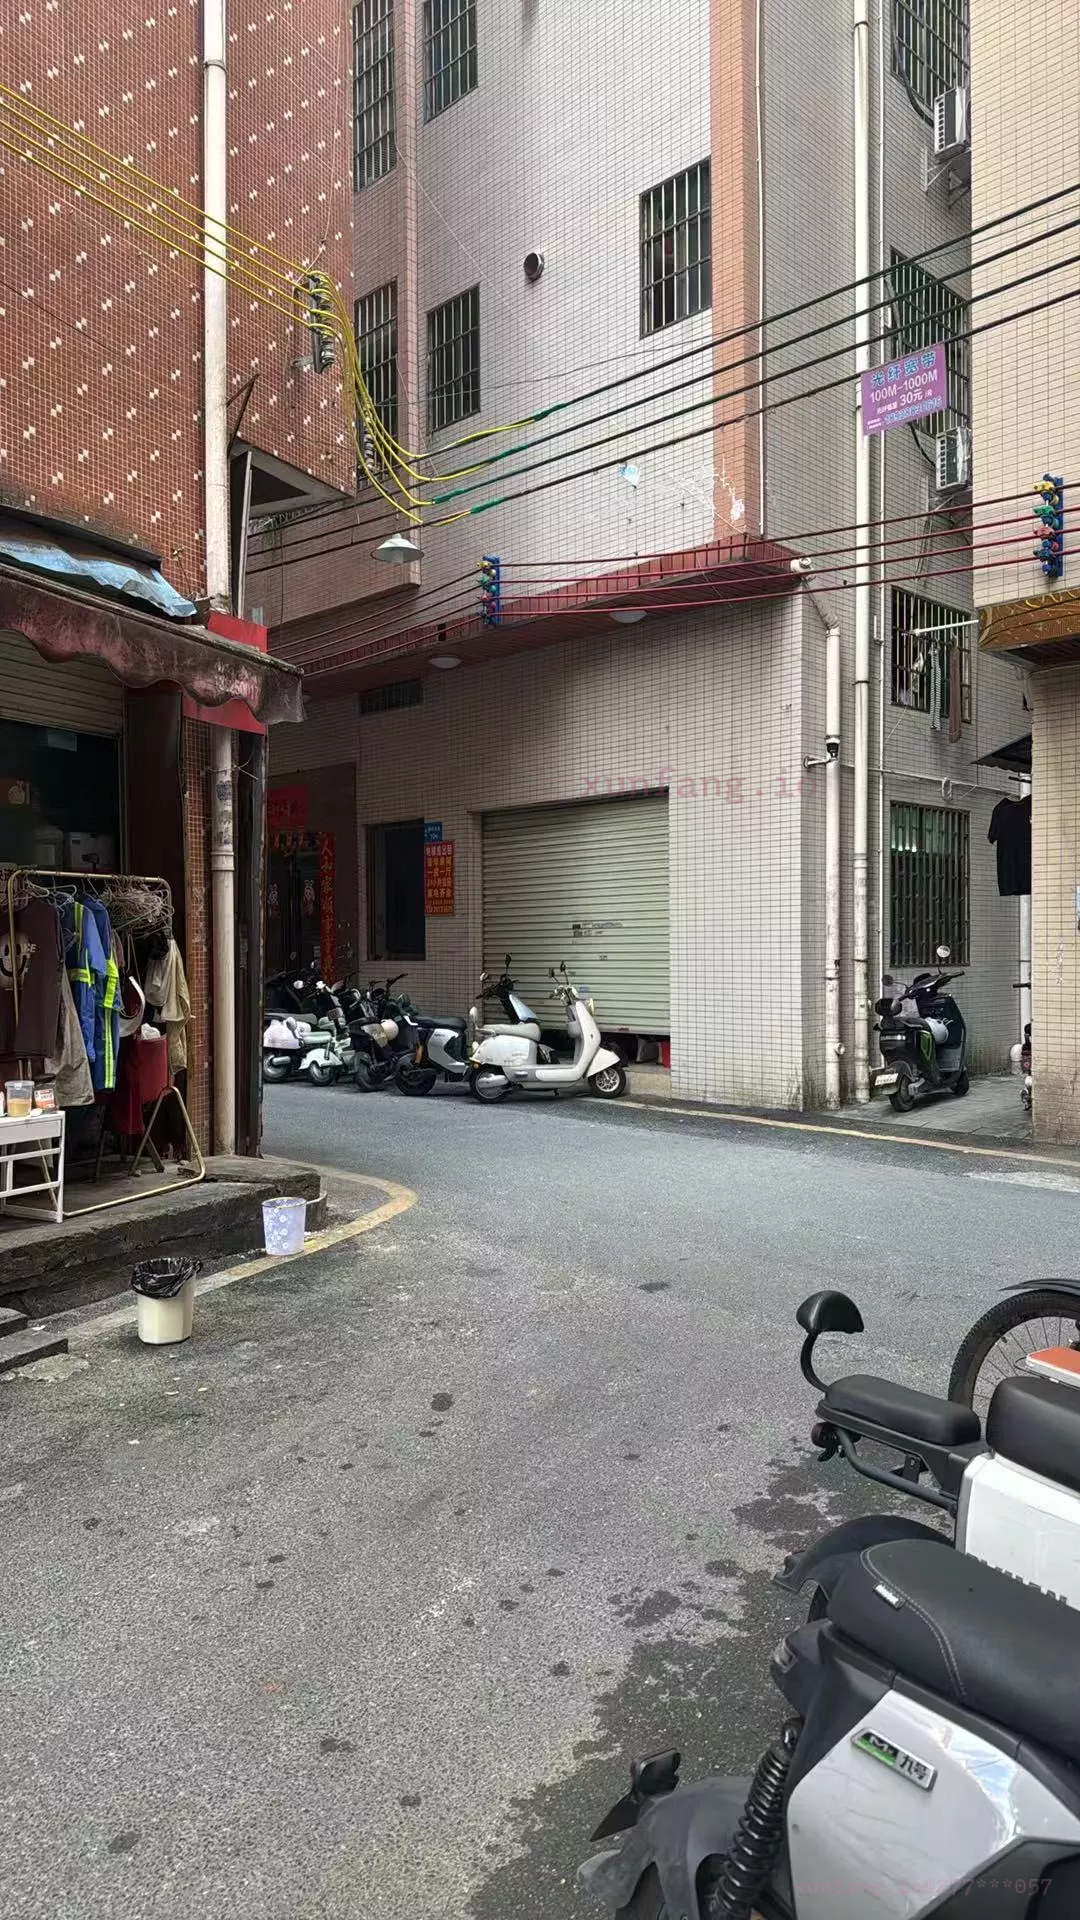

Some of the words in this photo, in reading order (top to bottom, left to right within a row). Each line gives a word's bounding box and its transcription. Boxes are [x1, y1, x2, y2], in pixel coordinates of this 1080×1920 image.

[871, 350, 936, 389] 光纤宽带
[870, 369, 938, 403] 100M-1000M
[900, 389, 923, 407] 30元
[900, 1754, 927, 1781] 九号
